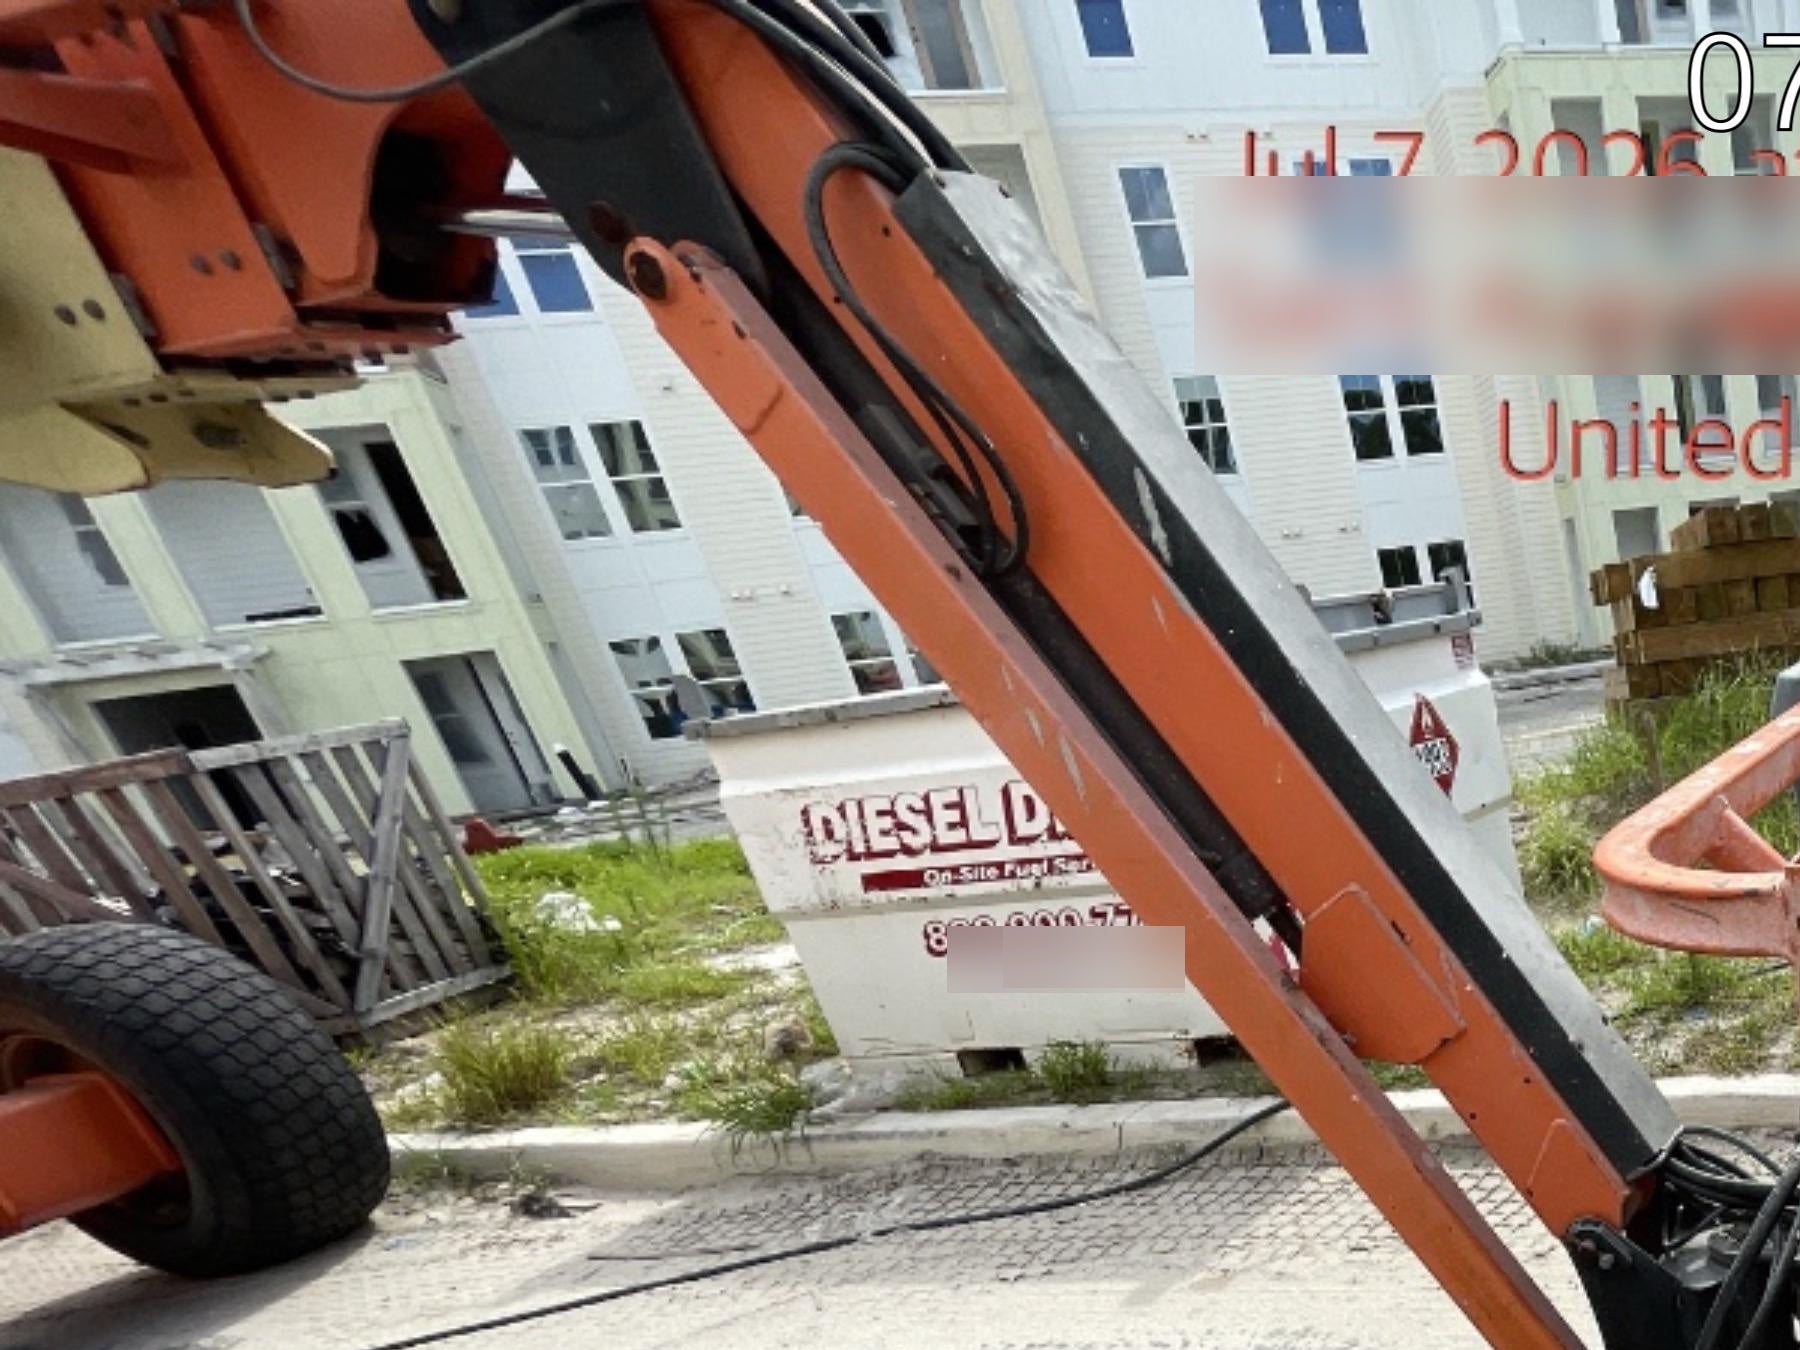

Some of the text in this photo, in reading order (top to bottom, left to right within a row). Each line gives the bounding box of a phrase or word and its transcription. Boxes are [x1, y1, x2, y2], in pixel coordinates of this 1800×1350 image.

[800, 785, 1000, 864] DIESEL
[923, 857, 1097, 886] On-Site Fuel Ser
